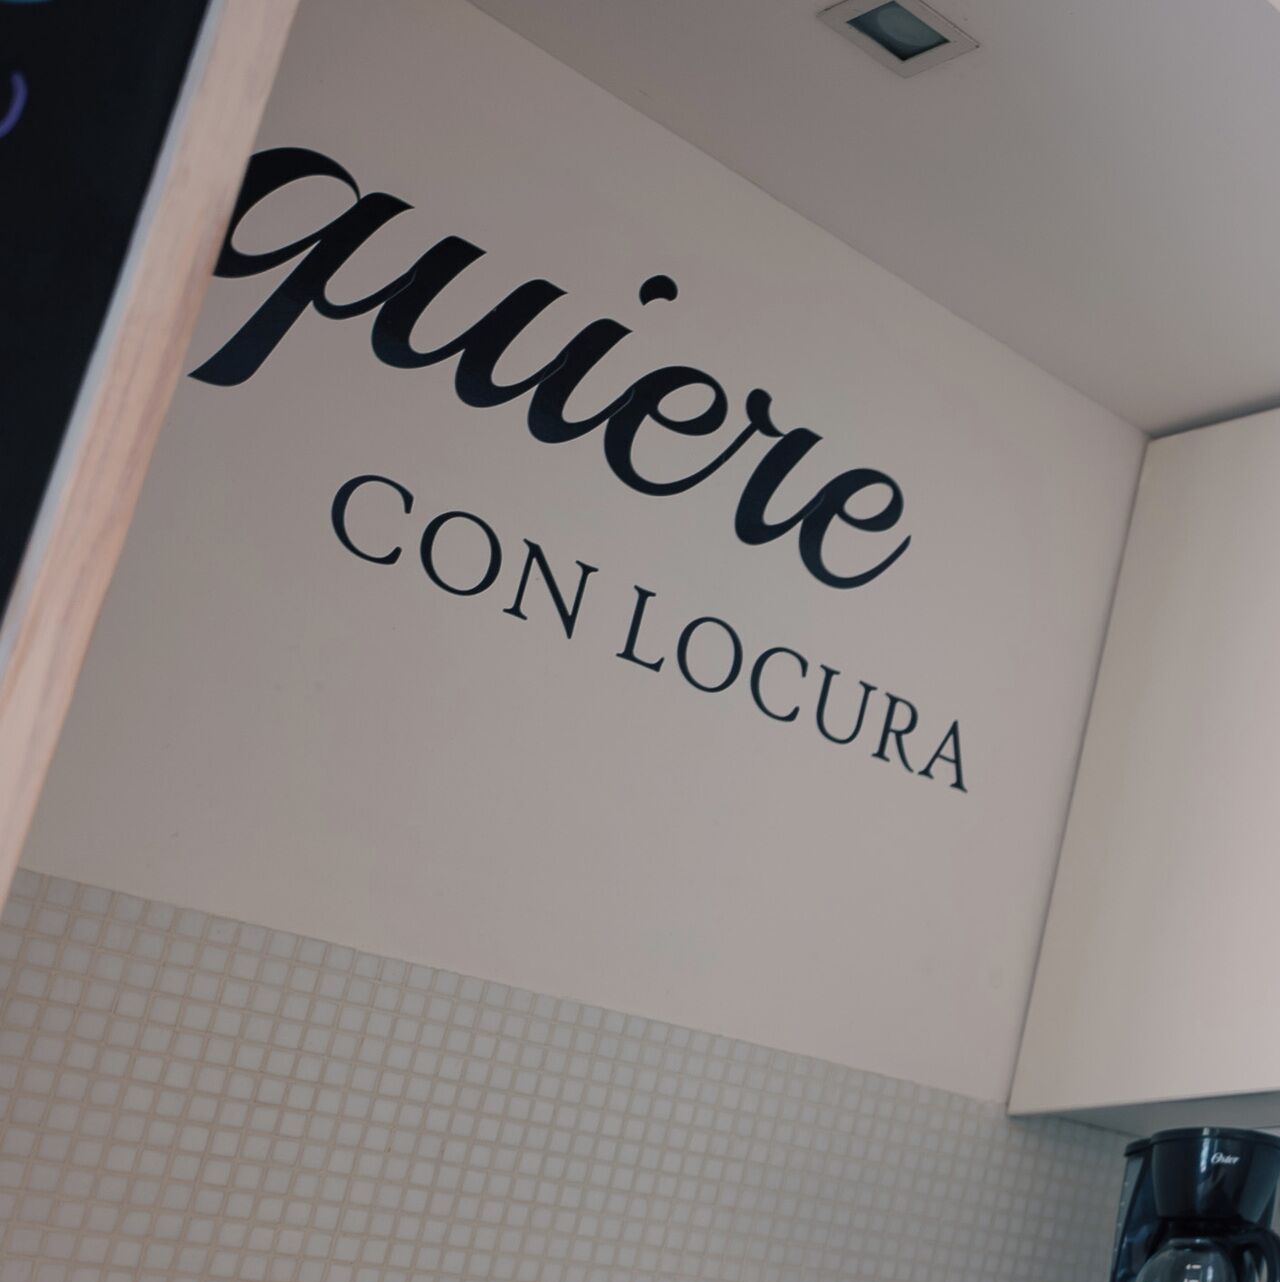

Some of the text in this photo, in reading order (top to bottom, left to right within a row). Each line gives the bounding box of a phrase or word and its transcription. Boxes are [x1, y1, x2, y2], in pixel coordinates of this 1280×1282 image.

[188, 147, 911, 589] quiere
[331, 473, 969, 793] CON LOCURA
